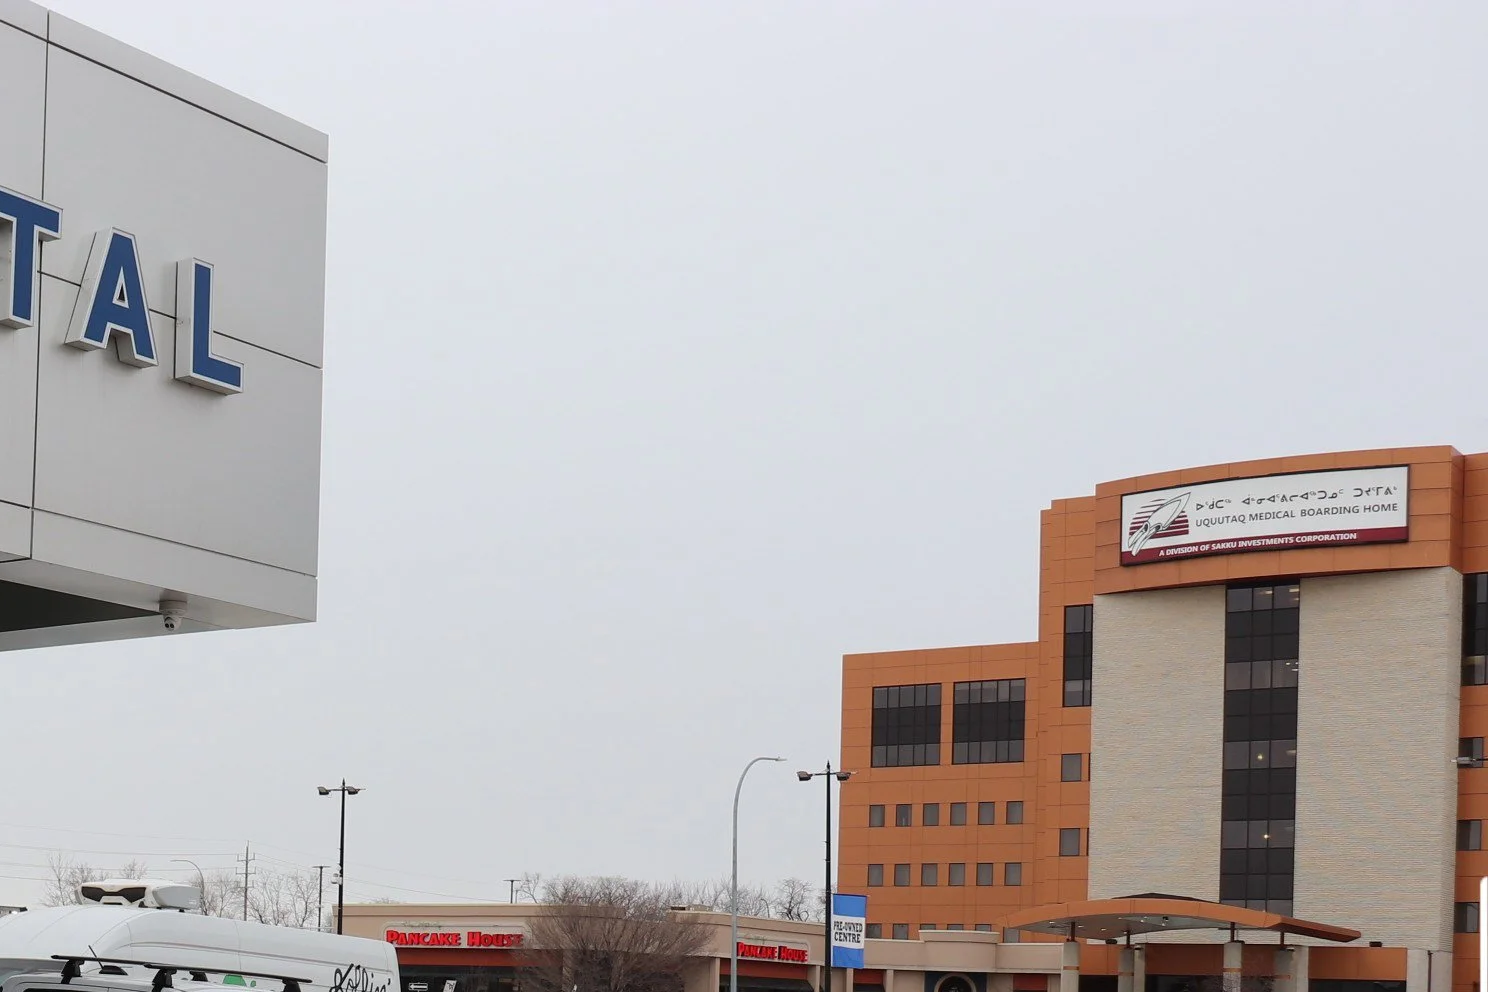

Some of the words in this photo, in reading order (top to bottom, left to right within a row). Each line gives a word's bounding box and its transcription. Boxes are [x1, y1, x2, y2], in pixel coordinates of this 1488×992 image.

[1195, 513, 1246, 527] UQUUTAQ
[1249, 509, 1295, 521] MEDICAL
[1300, 505, 1360, 517] BOARDING
[1363, 503, 1398, 513] HOME
[1159, 549, 1165, 557] A
[1166, 545, 1199, 556] DIVISION
[1200, 544, 1210, 552] OF
[1211, 541, 1237, 551] SAKKU
[1238, 536, 1294, 549] INVESTMENTS
[1295, 532, 1357, 544] CORPORATION
[833, 921, 863, 933] PRE-OWNED
[386, 930, 462, 946] PANCAKE
[467, 931, 524, 948] HOUSE
[834, 931, 861, 943] CENTRE
[737, 942, 778, 960] PANCAKE
[778, 945, 808, 963] HOUSE
